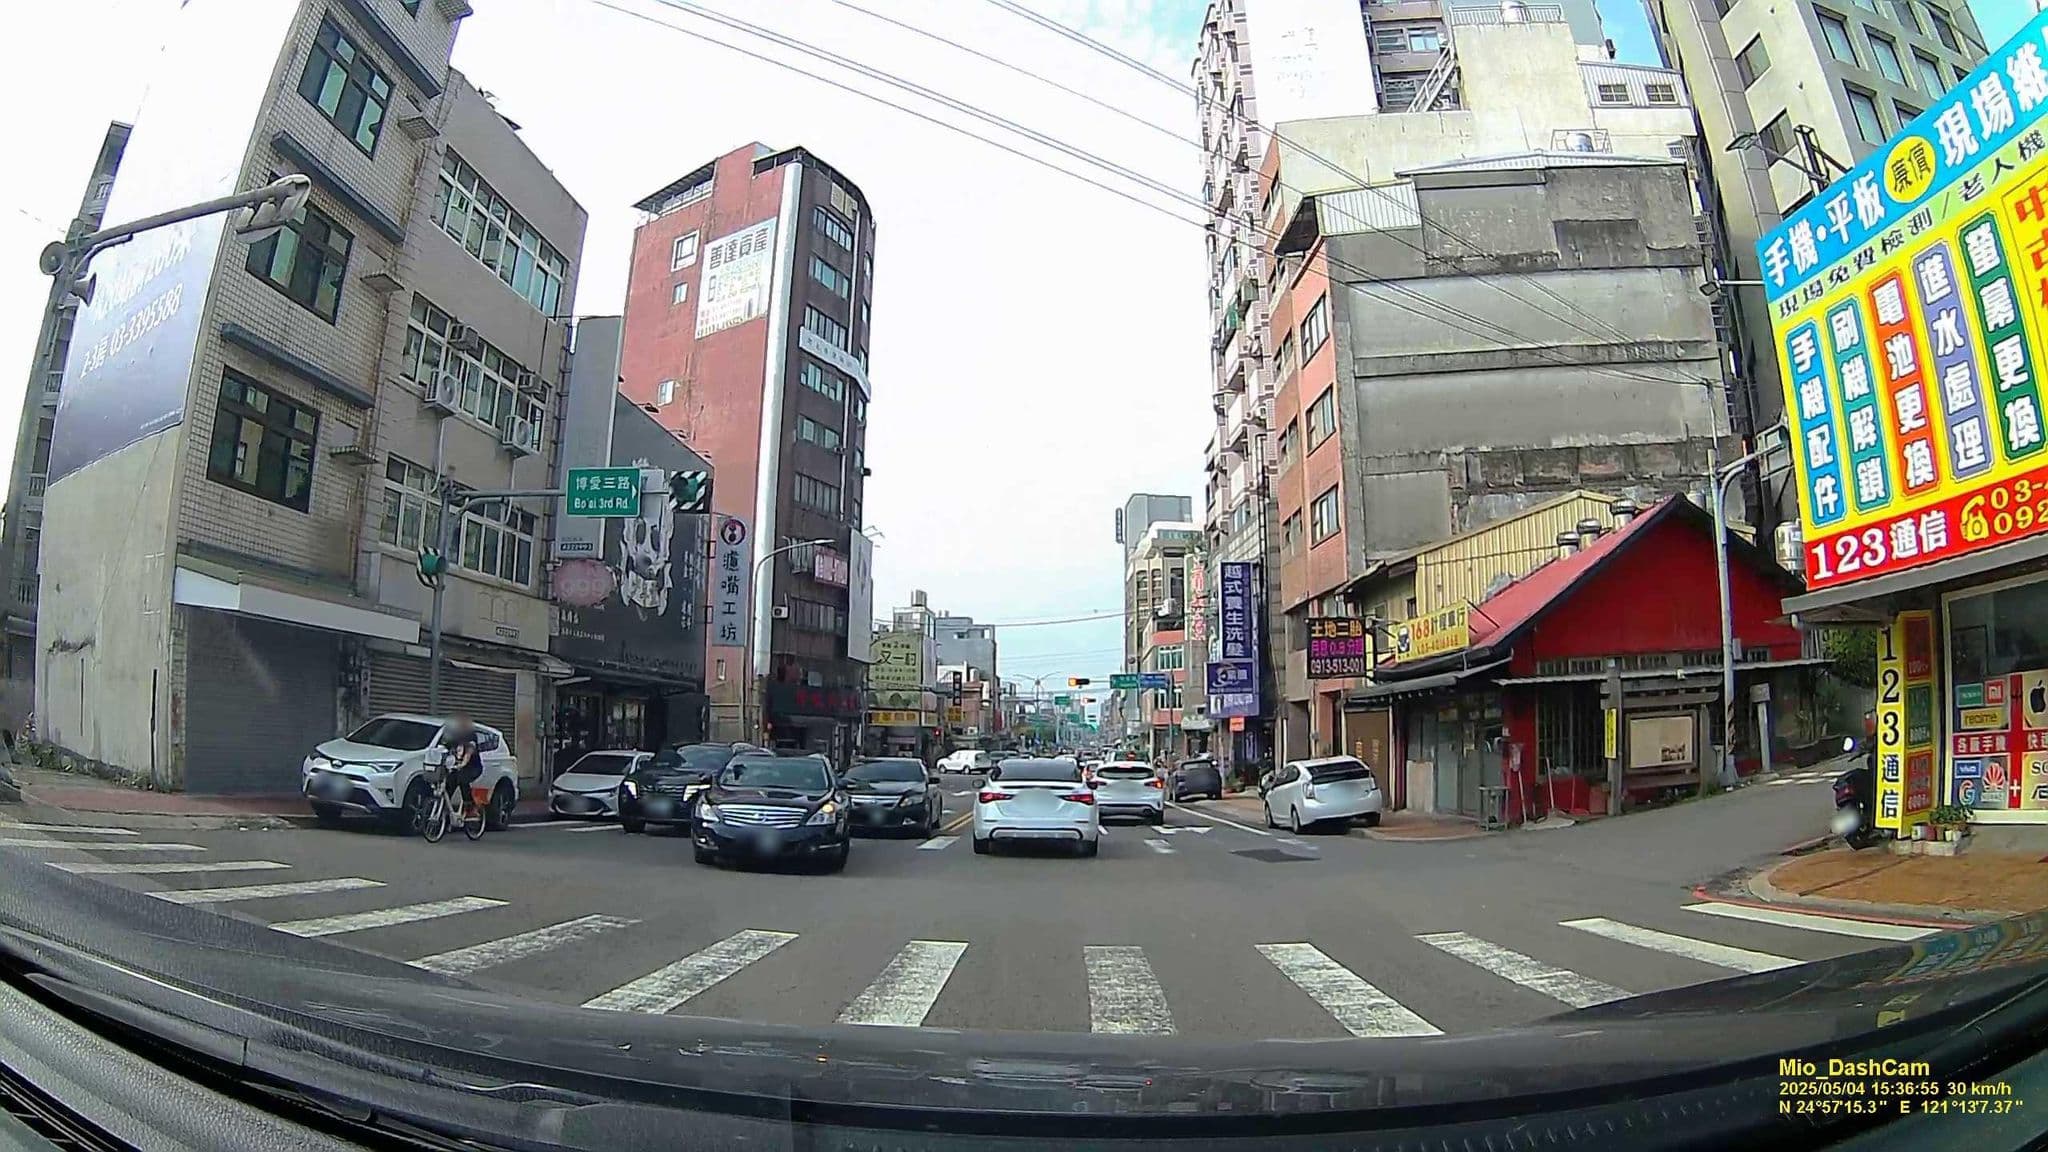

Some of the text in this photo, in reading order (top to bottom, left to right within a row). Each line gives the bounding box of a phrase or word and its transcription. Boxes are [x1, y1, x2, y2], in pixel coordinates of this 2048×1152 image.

[1891, 141, 1931, 194] 廉價
[1933, 26, 2048, 168] 現場維
[1831, 305, 1886, 503] 刷機解鎖
[1873, 278, 1935, 488] 電池更換
[1918, 252, 1986, 472] 進水處理
[1964, 220, 2041, 451] 螢幕更換
[576, 475, 630, 491] 博愛三路
[598, 497, 614, 509] 3rd
[1790, 329, 1839, 518] 手機配件
[1990, 479, 2048, 510] 03-
[720, 550, 740, 641] 濾嘴工坊
[1810, 509, 1948, 580] 123通信
[1311, 620, 1363, 638] 土地二胎
[1881, 626, 1901, 819] 123通信
